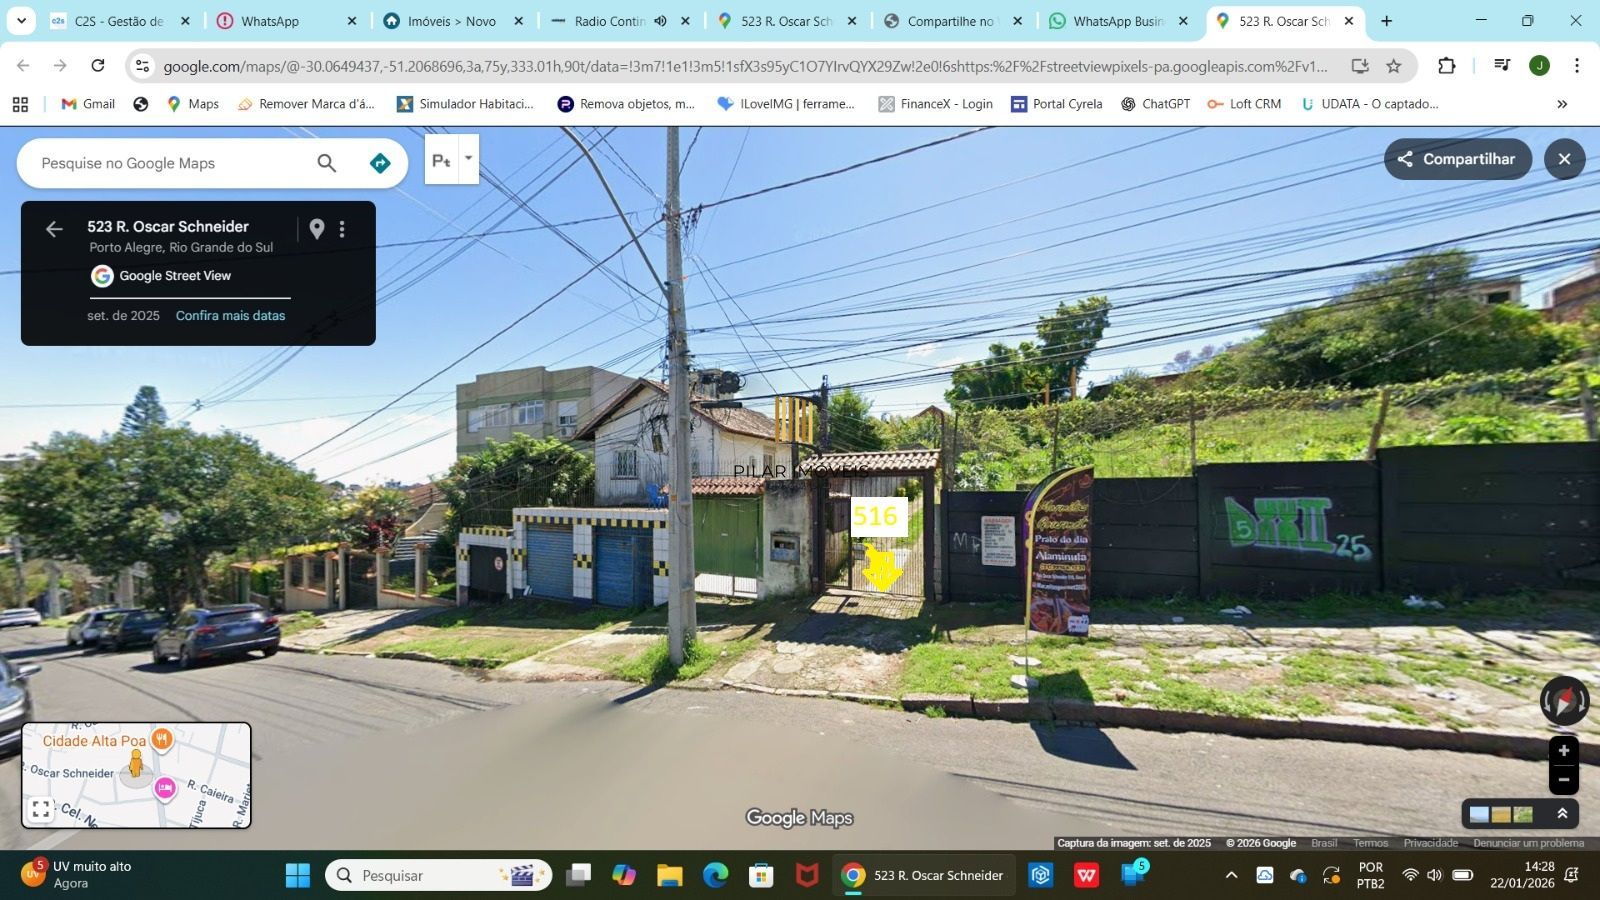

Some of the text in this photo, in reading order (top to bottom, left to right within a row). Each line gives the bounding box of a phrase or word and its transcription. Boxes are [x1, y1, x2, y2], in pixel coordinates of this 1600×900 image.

[75, 16, 95, 26] C2S
[108, 16, 146, 26] Gestão
[150, 16, 164, 27] de
[242, 16, 299, 28] WhatsApp
[409, 17, 450, 26] Imóveis
[467, 17, 496, 26] Novo
[576, 16, 647, 27] Radio Contin
[742, 15, 833, 27] 523 R. Oscar Sch
[909, 16, 994, 28] Compartilhe no
[1074, 17, 1131, 28] WhatsApp
[1240, 16, 1331, 27] 523 R. Oscar Sch
[1537, 60, 1543, 71] J
[84, 99, 114, 109] Gmail
[190, 99, 218, 111] Maps
[260, 99, 307, 109] Remover
[312, 99, 345, 109] Marca
[421, 99, 476, 109] Simulador
[581, 99, 623, 109] Remova
[628, 99, 671, 111] objetos,
[902, 99, 950, 109] FinanceX
[963, 99, 992, 111] Login
[1034, 99, 1102, 111] Portal Cyrela
[1143, 99, 1190, 109] ChatGPT
[1231, 99, 1281, 109] Loft CRM
[1323, 99, 1360, 109] UDATA
[1372, 99, 1381, 109] O
[43, 157, 215, 172] Pesquise no Google Maps
[433, 154, 450, 167] Pt
[1423, 152, 1516, 167] Compartilhar
[88, 220, 249, 232] 523 R. Oscar Schneider
[89, 242, 273, 255] Porto Alegre, Rio Grande do Sul
[120, 269, 231, 283] Google Street View
[88, 310, 160, 320] set. de 2025
[175, 310, 285, 321] Confira mais datas
[1059, 535, 1072, 544] do
[1073, 535, 1089, 544] dia
[1336, 534, 1372, 561] 25
[43, 734, 146, 747] Cidade Alta Poa
[30, 764, 60, 778] Oscar
[63, 768, 114, 778] Schneider
[187, 779, 234, 804] R. Caieira
[61, 803, 81, 820] Cel.
[746, 807, 855, 830] Google Maps
[1057, 838, 1211, 849] Captura da imagem: set. de 2025
[1237, 838, 1260, 848] 2026
[1262, 838, 1297, 850] Google
[1311, 838, 1338, 848] Brasil
[1354, 838, 1389, 848] Termos
[1404, 838, 1459, 848] Privacidade
[1473, 838, 1585, 850] Denunciar um problema
[37, 861, 44, 870] 5
[54, 861, 131, 871] UV muito alto
[1138, 861, 1145, 871] 5
[1360, 862, 1383, 872] POR
[1526, 861, 1555, 871] 14:28
[27, 870, 39, 879] UV
[364, 870, 423, 884] Pesquisar
[875, 870, 1003, 880] 523 R. Oscar Schneider
[54, 878, 88, 890] Agora
[1358, 879, 1384, 888] PTB2
[1491, 878, 1555, 888] 22/01/2026
